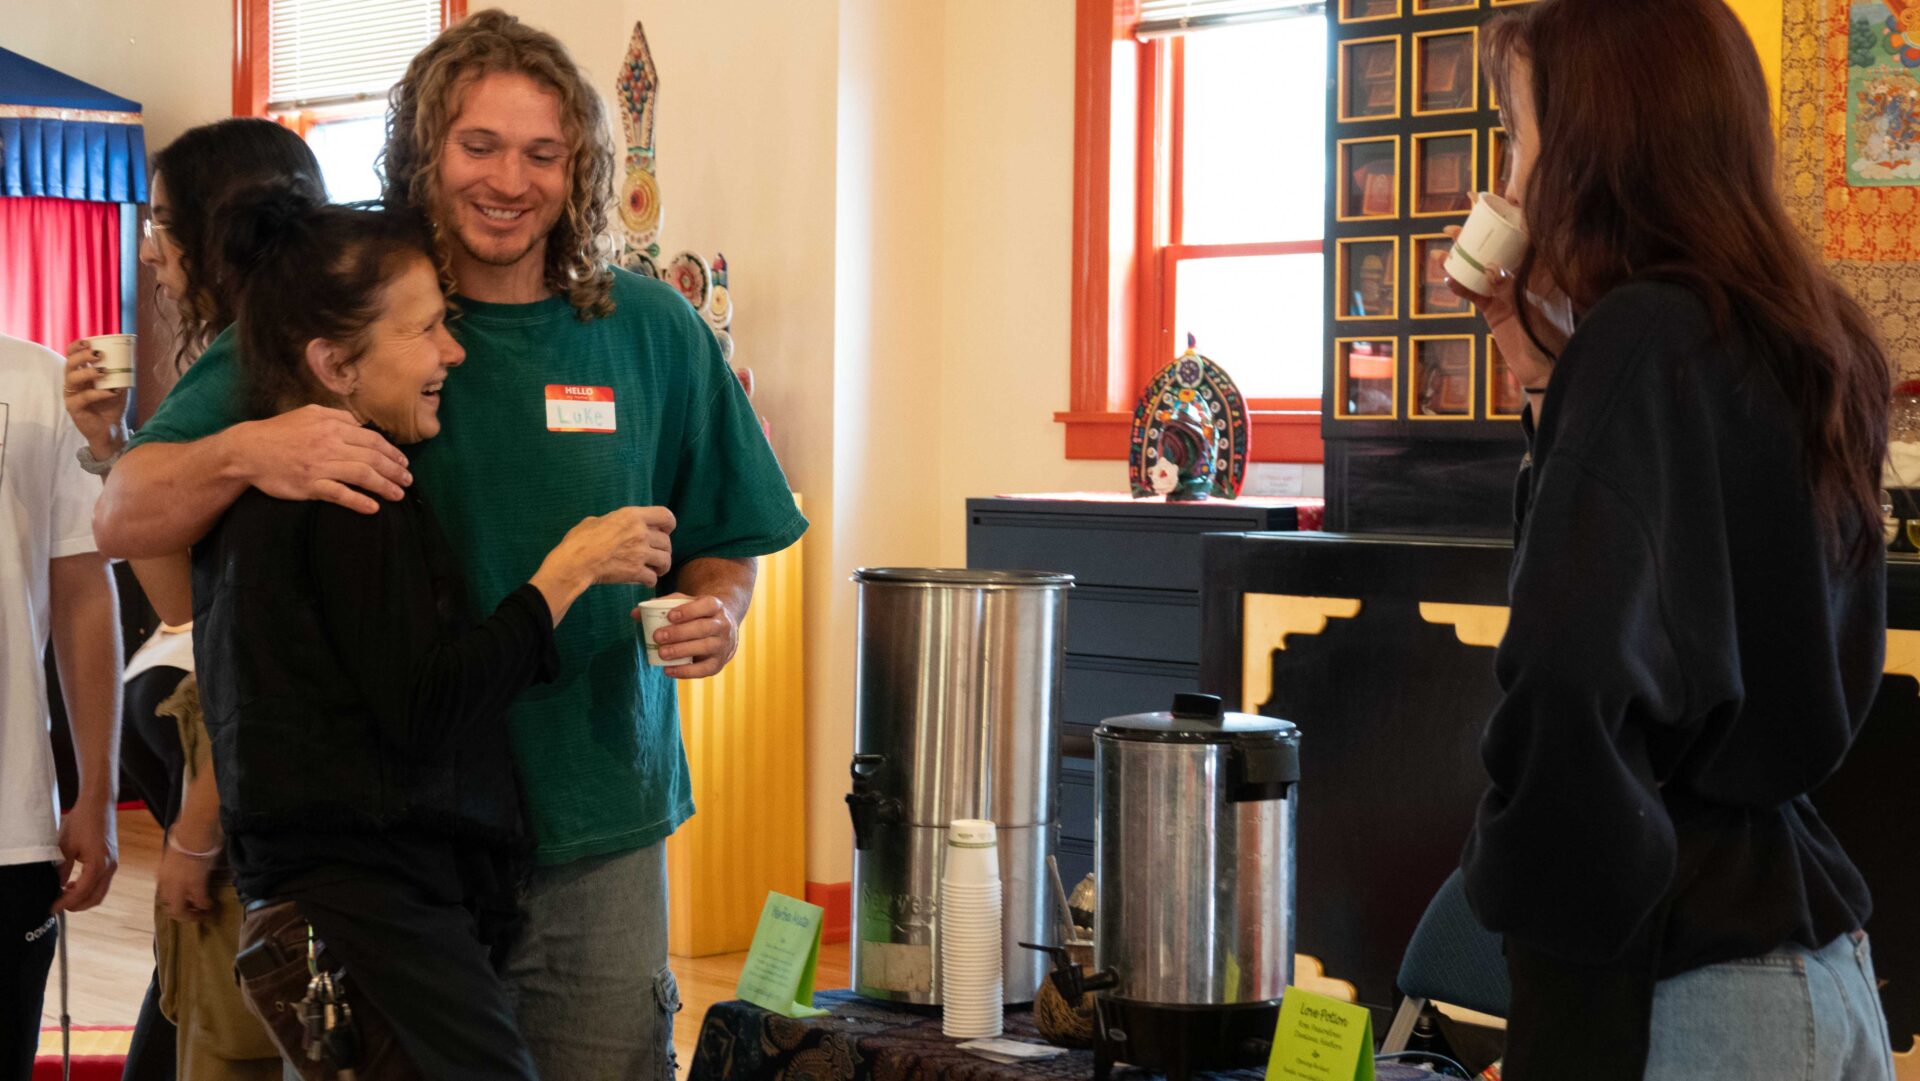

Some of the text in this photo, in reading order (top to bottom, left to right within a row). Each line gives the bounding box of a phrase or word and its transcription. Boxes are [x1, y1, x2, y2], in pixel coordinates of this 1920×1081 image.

[565, 387, 593, 395] HELLO
[557, 405, 603, 426] Luke
[1300, 1002, 1348, 1028] Love Potion
